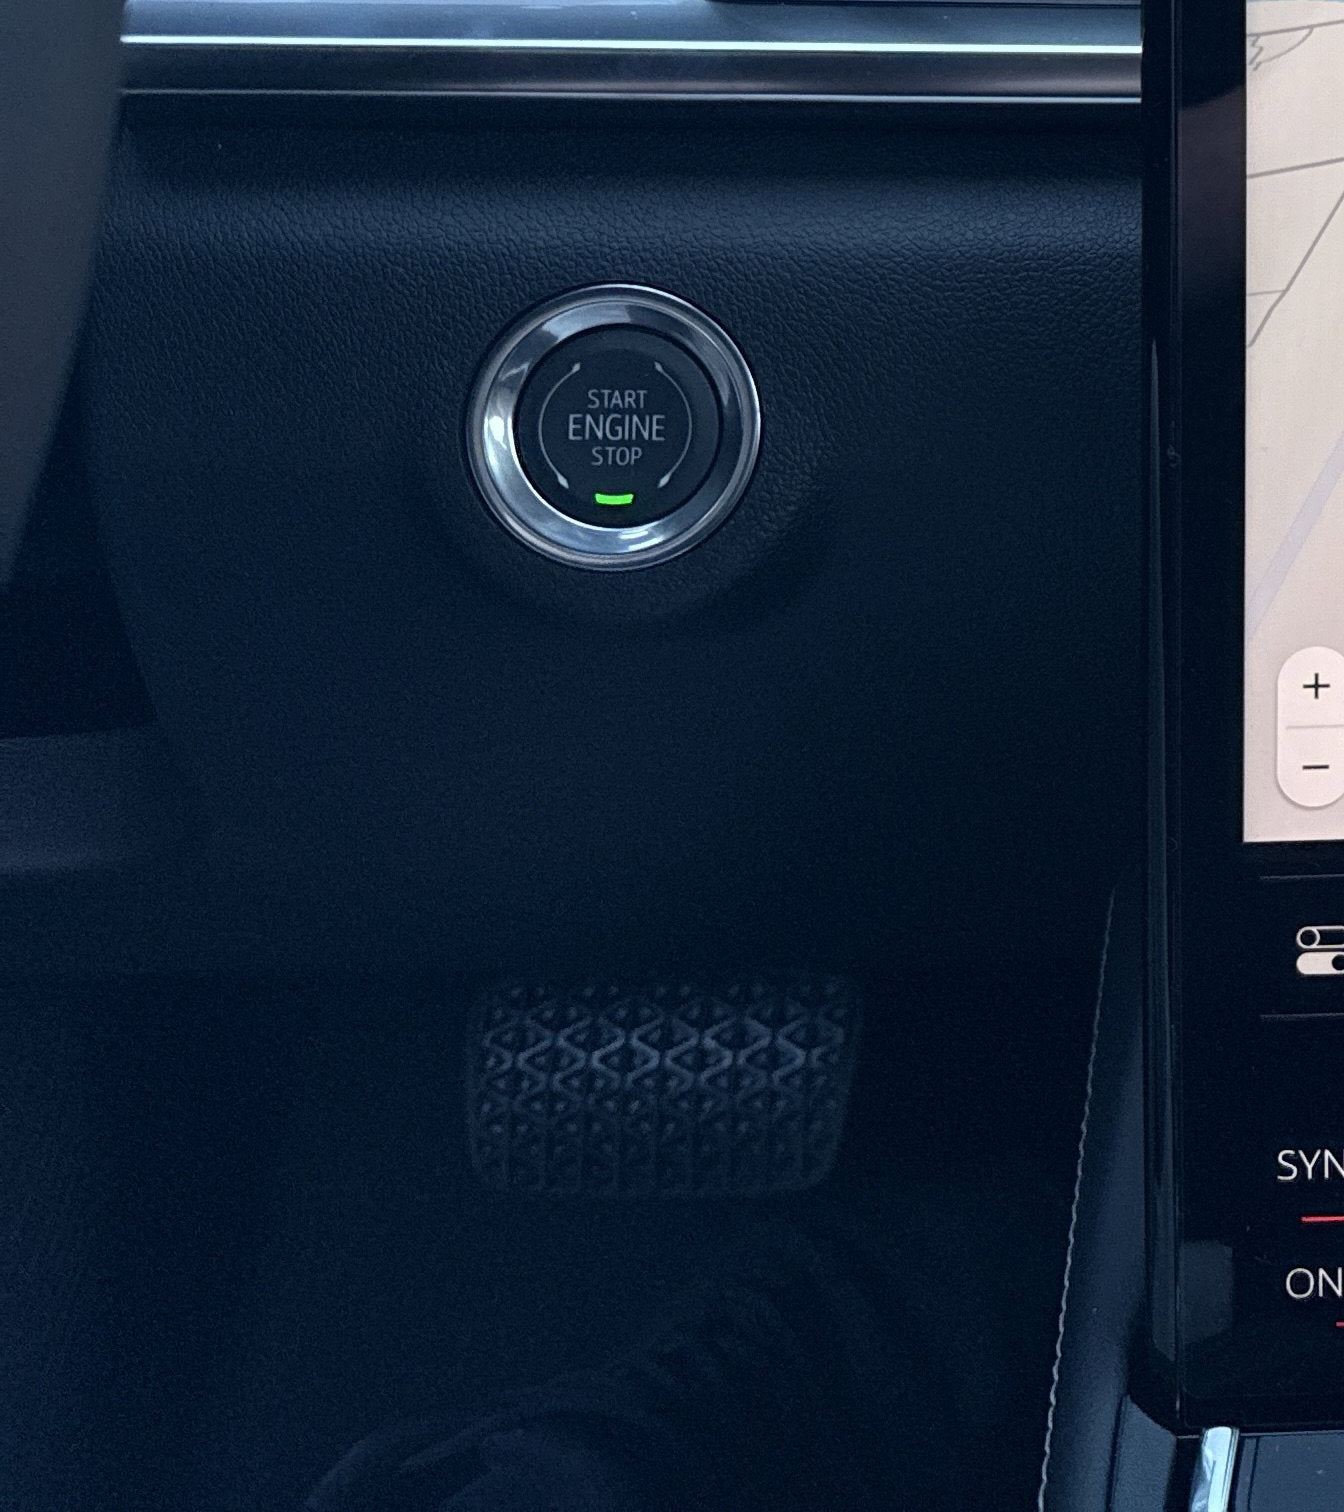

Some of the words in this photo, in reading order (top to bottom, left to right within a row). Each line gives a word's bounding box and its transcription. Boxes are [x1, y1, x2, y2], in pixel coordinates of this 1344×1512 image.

[588, 390, 647, 408] START
[569, 415, 665, 440] ENGINE
[591, 447, 642, 465] STOP
